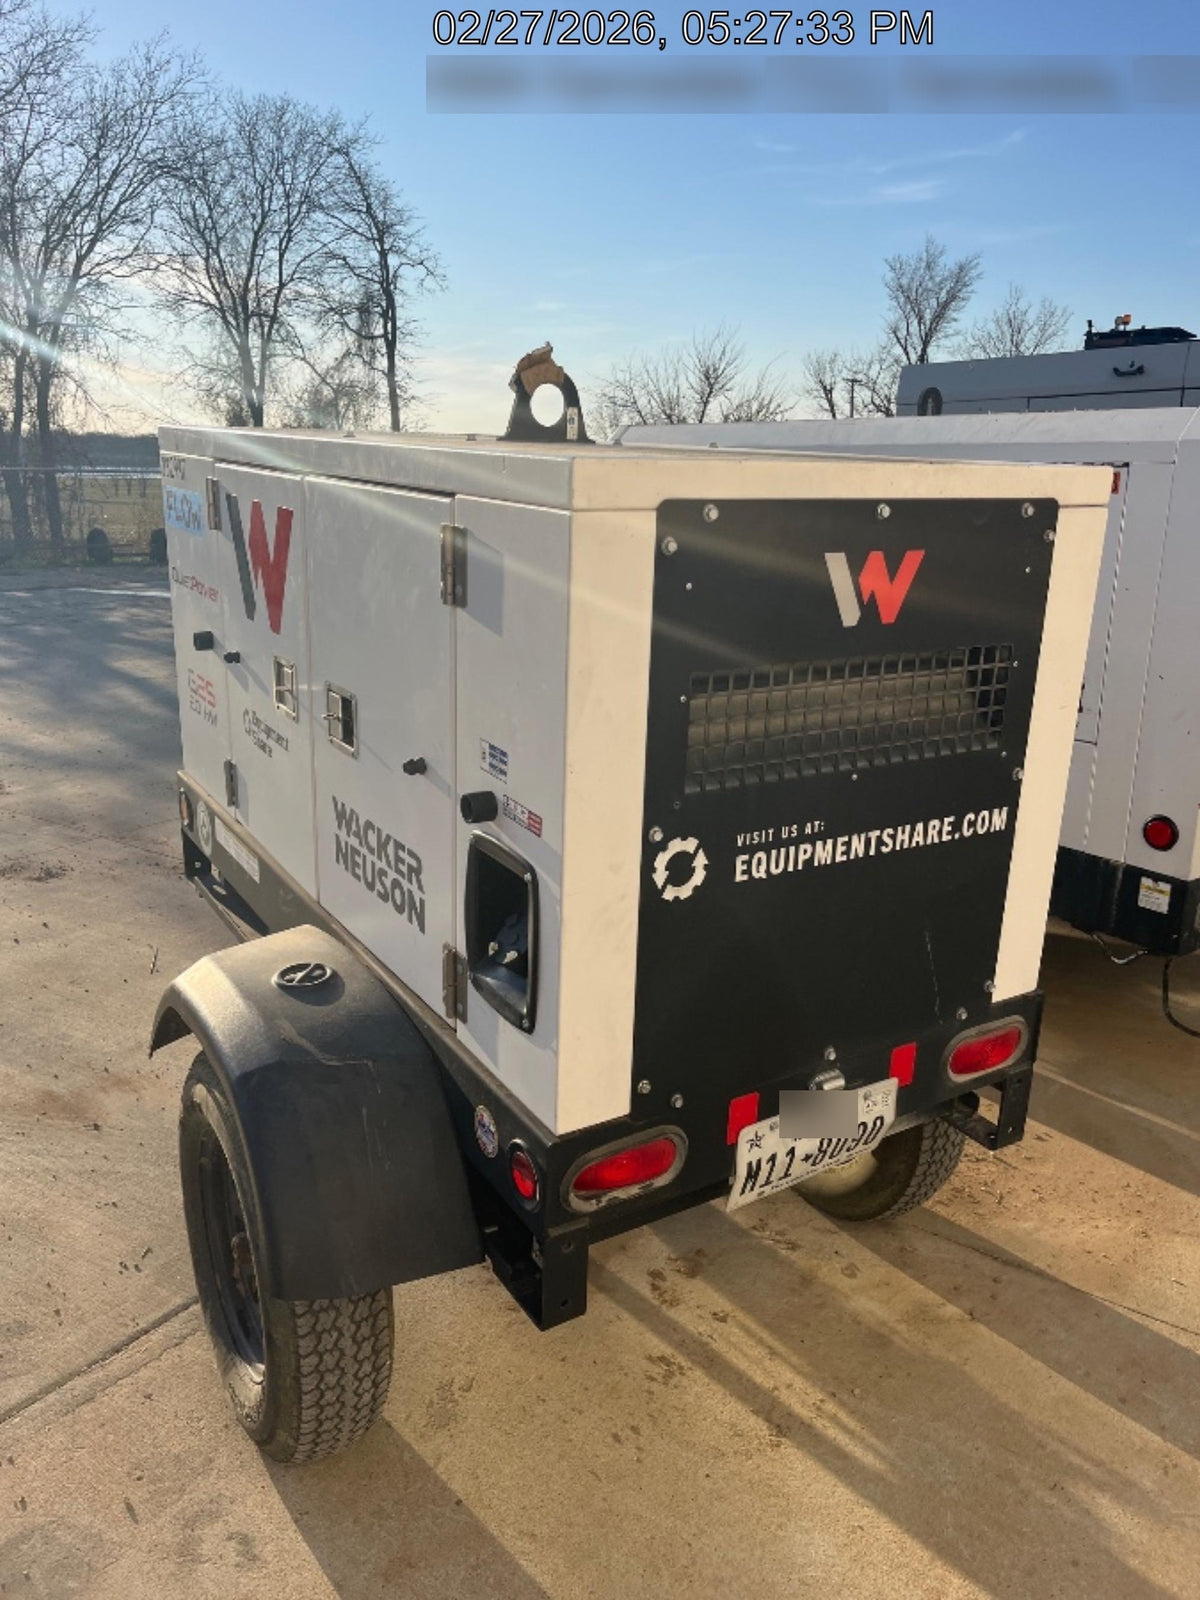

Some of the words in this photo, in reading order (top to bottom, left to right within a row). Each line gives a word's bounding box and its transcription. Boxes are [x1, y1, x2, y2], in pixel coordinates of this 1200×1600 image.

[332, 795, 425, 895] WACKER
[734, 806, 1008, 883] EQUIPMENTSHARE.COM
[736, 828, 774, 847] VISIT
[781, 825, 798, 839] US
[804, 820, 825, 834] AT:
[335, 833, 425, 936] NEUSON
